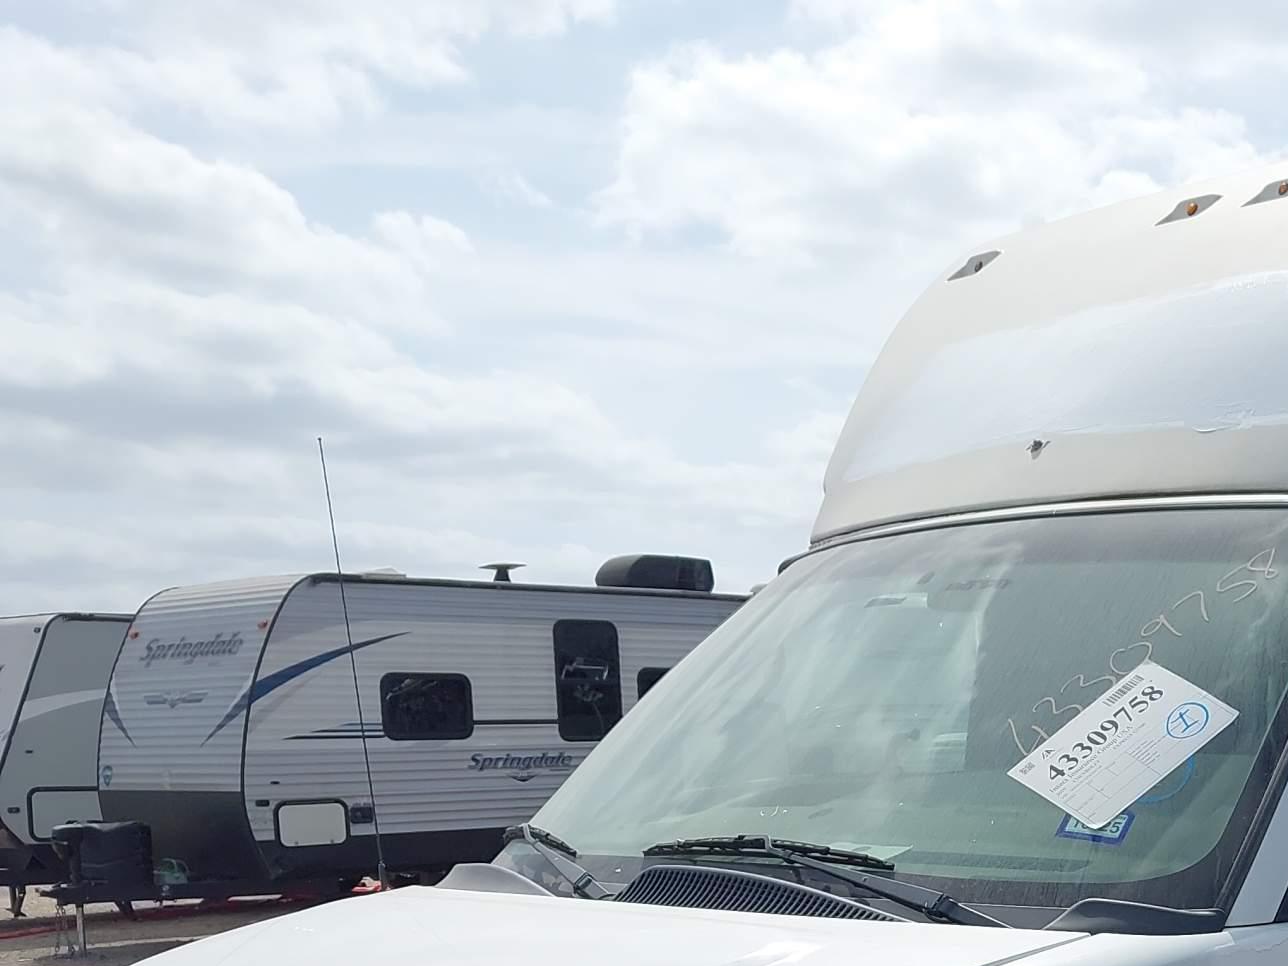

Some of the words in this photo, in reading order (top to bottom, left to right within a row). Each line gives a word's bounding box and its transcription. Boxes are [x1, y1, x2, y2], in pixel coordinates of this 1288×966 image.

[139, 632, 245, 668] Springdale
[1049, 685, 1164, 781] 43309758
[1097, 738, 1119, 755] Group
[467, 751, 574, 772] Springdale
